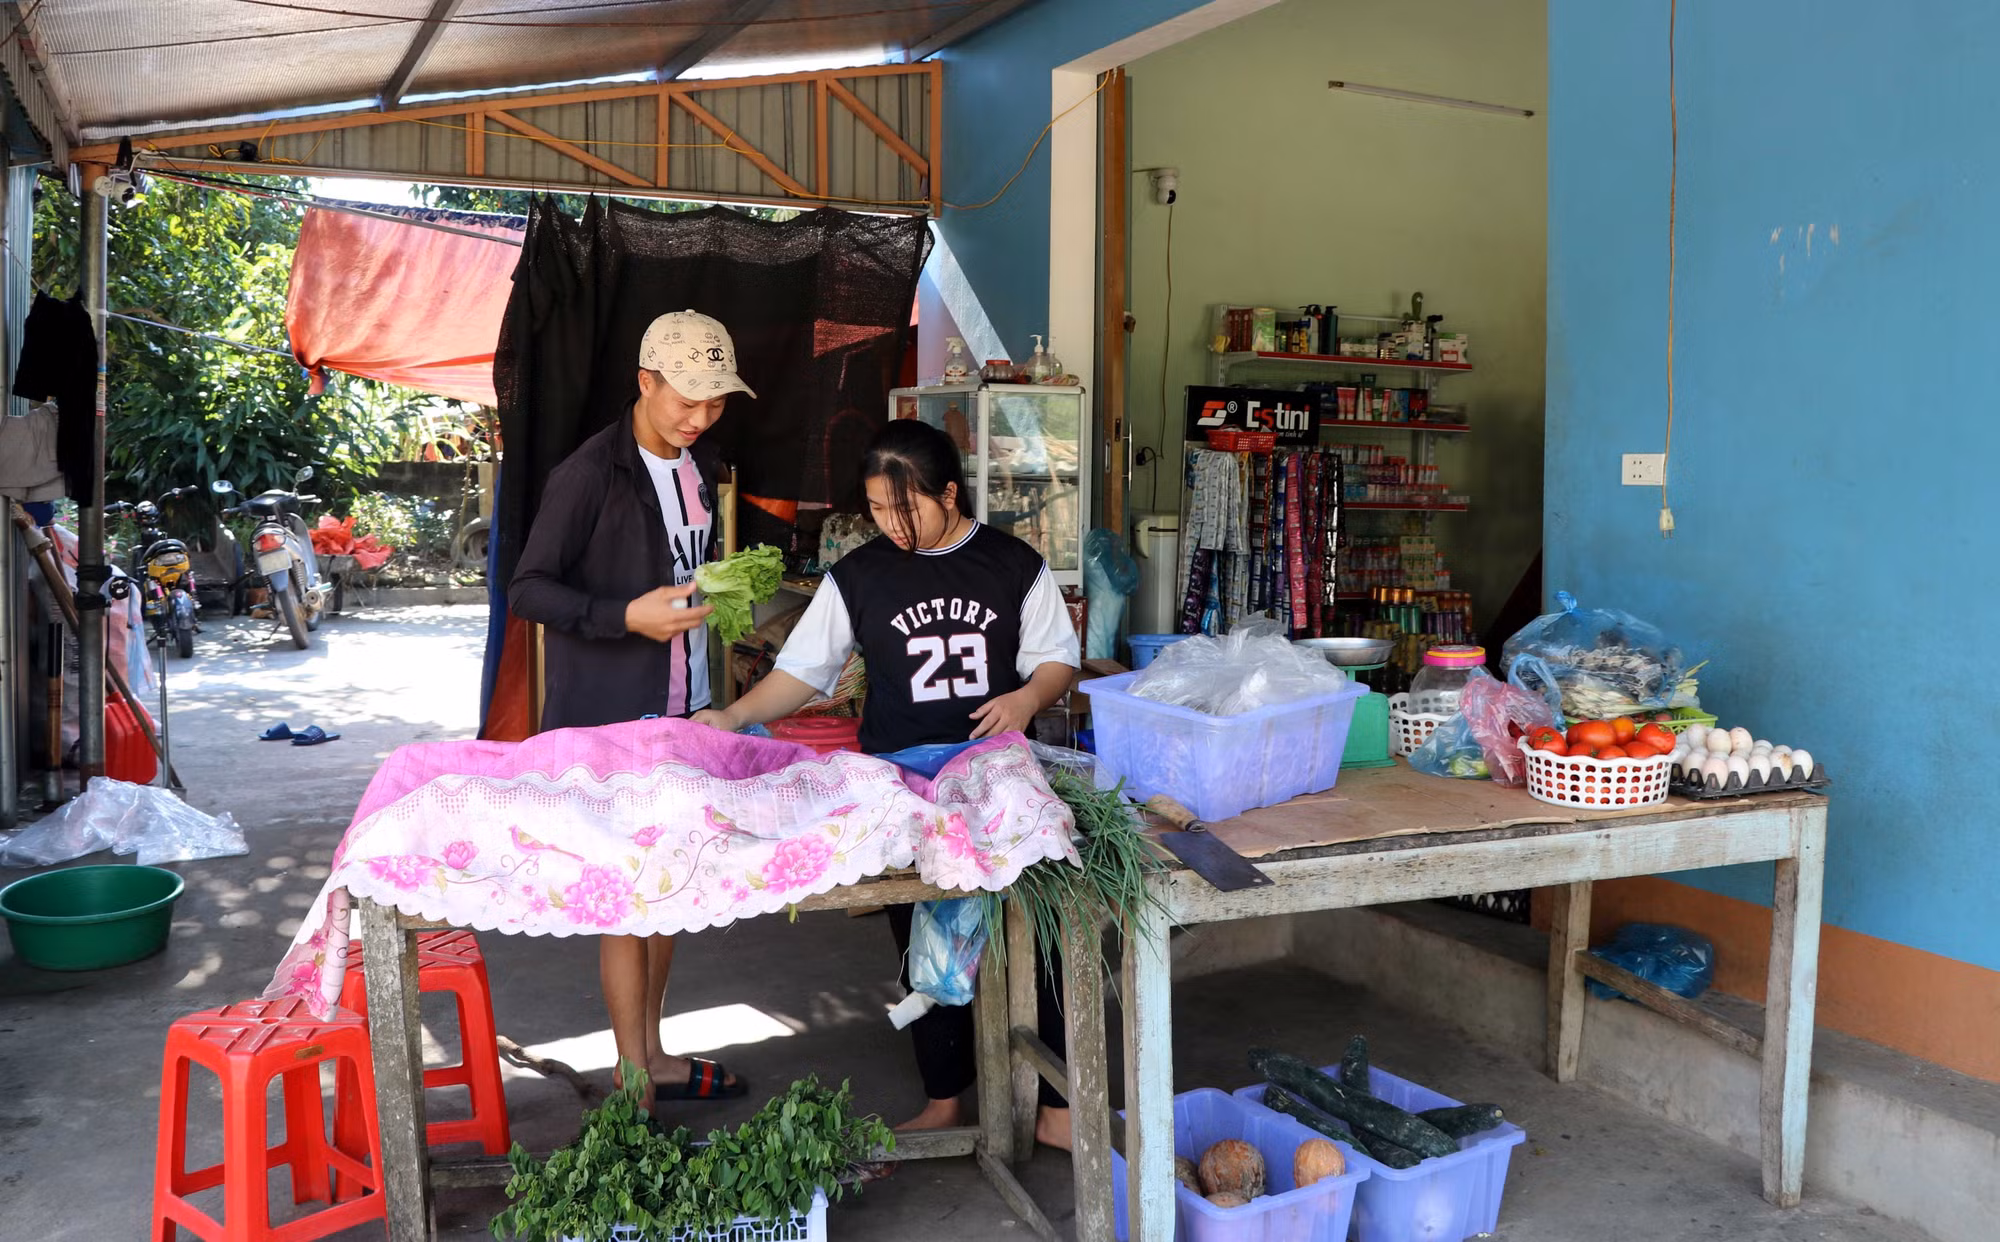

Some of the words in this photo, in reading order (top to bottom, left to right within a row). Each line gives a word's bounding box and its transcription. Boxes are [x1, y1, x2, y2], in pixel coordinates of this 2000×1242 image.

[1246, 400, 1311, 430] Estini
[890, 597, 998, 636] VICTORY
[906, 633, 990, 703] 23
